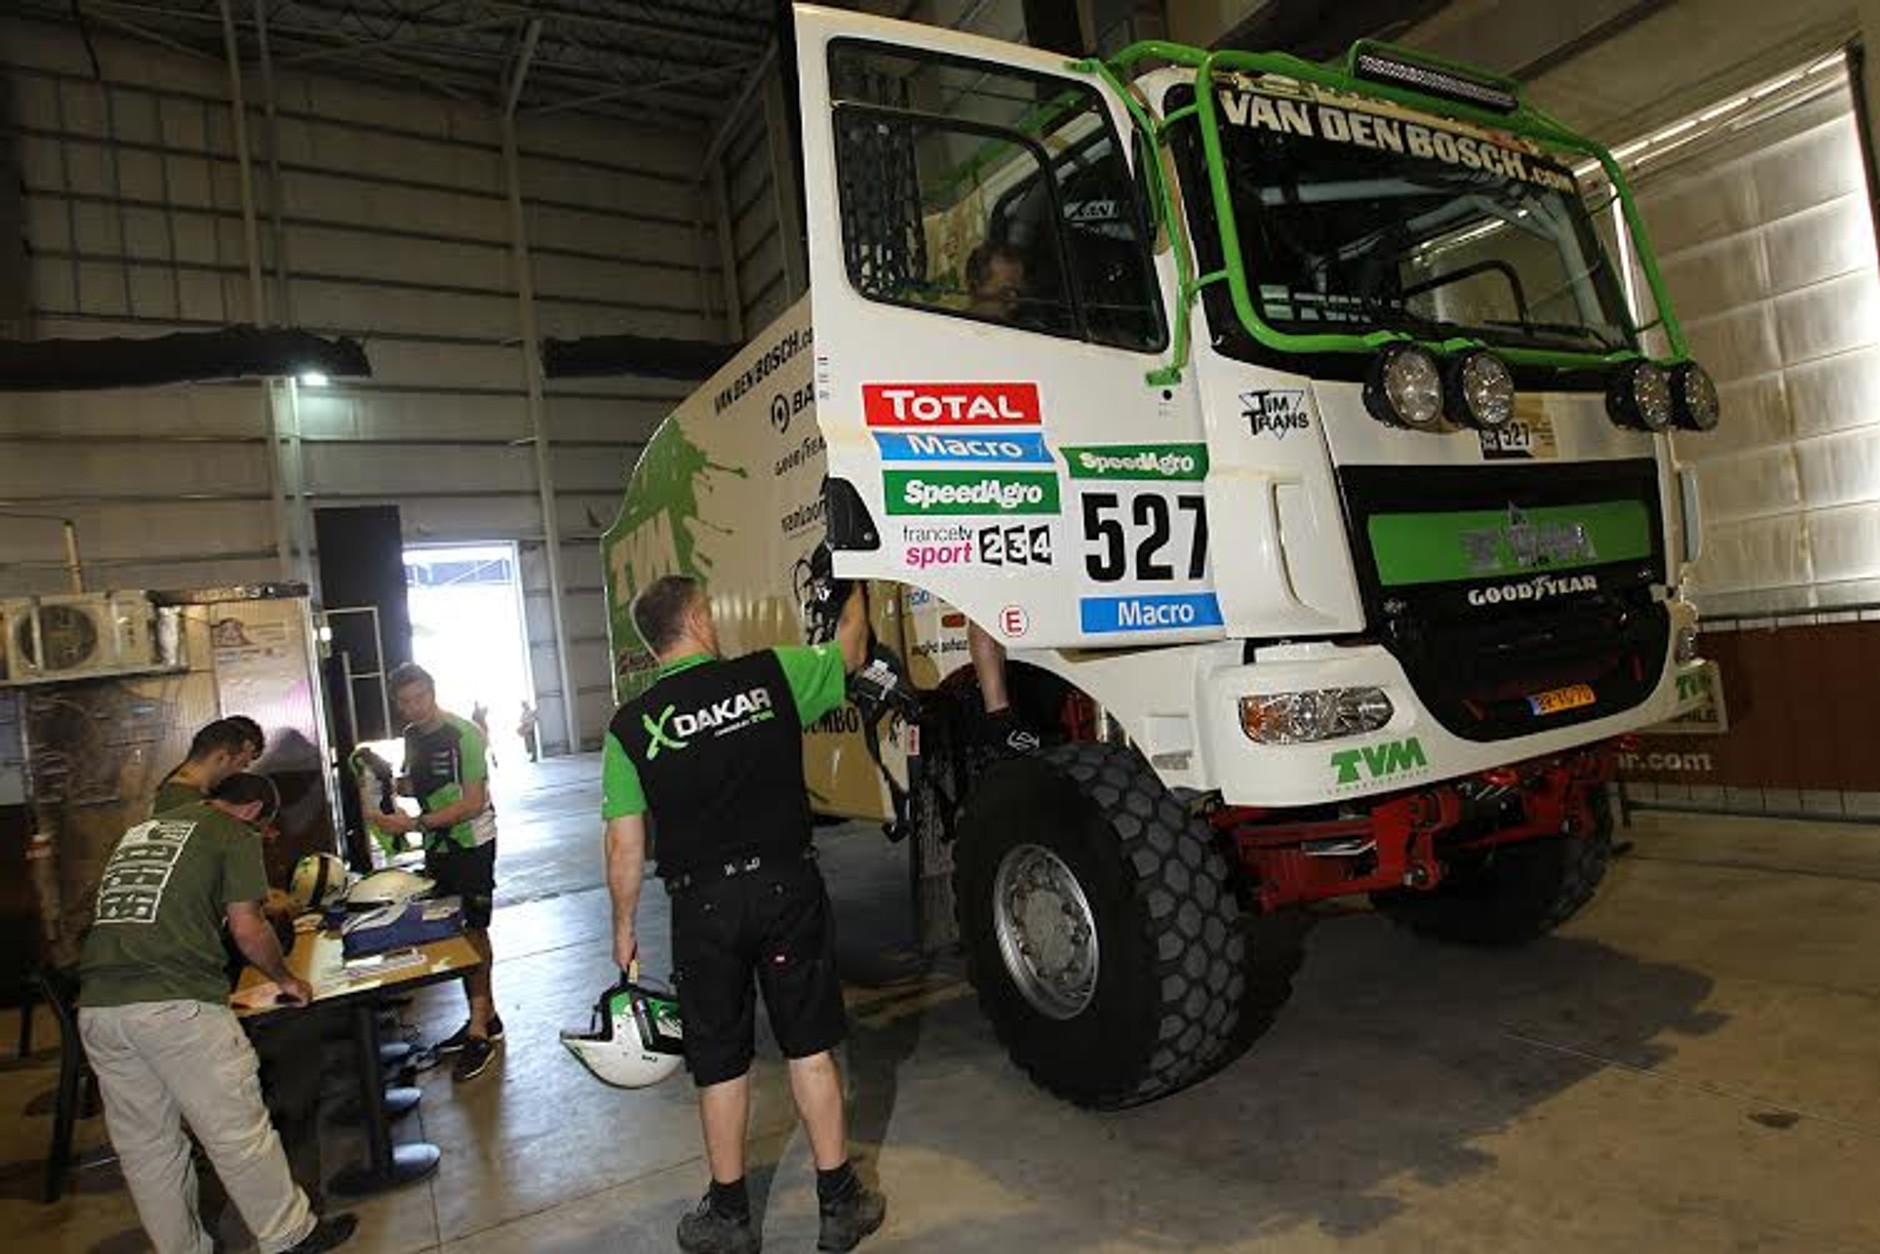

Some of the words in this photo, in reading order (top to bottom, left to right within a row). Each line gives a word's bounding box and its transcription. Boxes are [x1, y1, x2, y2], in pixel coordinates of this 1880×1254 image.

[1219, 90, 1314, 136] VAN
[1318, 106, 1404, 153] DEN
[734, 369, 754, 401] DEN
[881, 390, 1024, 421] TOTAL
[1251, 389, 1289, 415] TIM
[1242, 410, 1309, 435] TRANS
[906, 434, 1023, 458] Macro
[1079, 452, 1195, 475] SpeedAgro
[904, 480, 1043, 508] SpeedAgro
[1081, 491, 1209, 582] 527
[906, 542, 973, 568] sport
[1468, 575, 1598, 606] GOODYEAR
[1005, 609, 1023, 633] E
[1118, 600, 1195, 627] Macro
[1331, 737, 1427, 784] TVM
